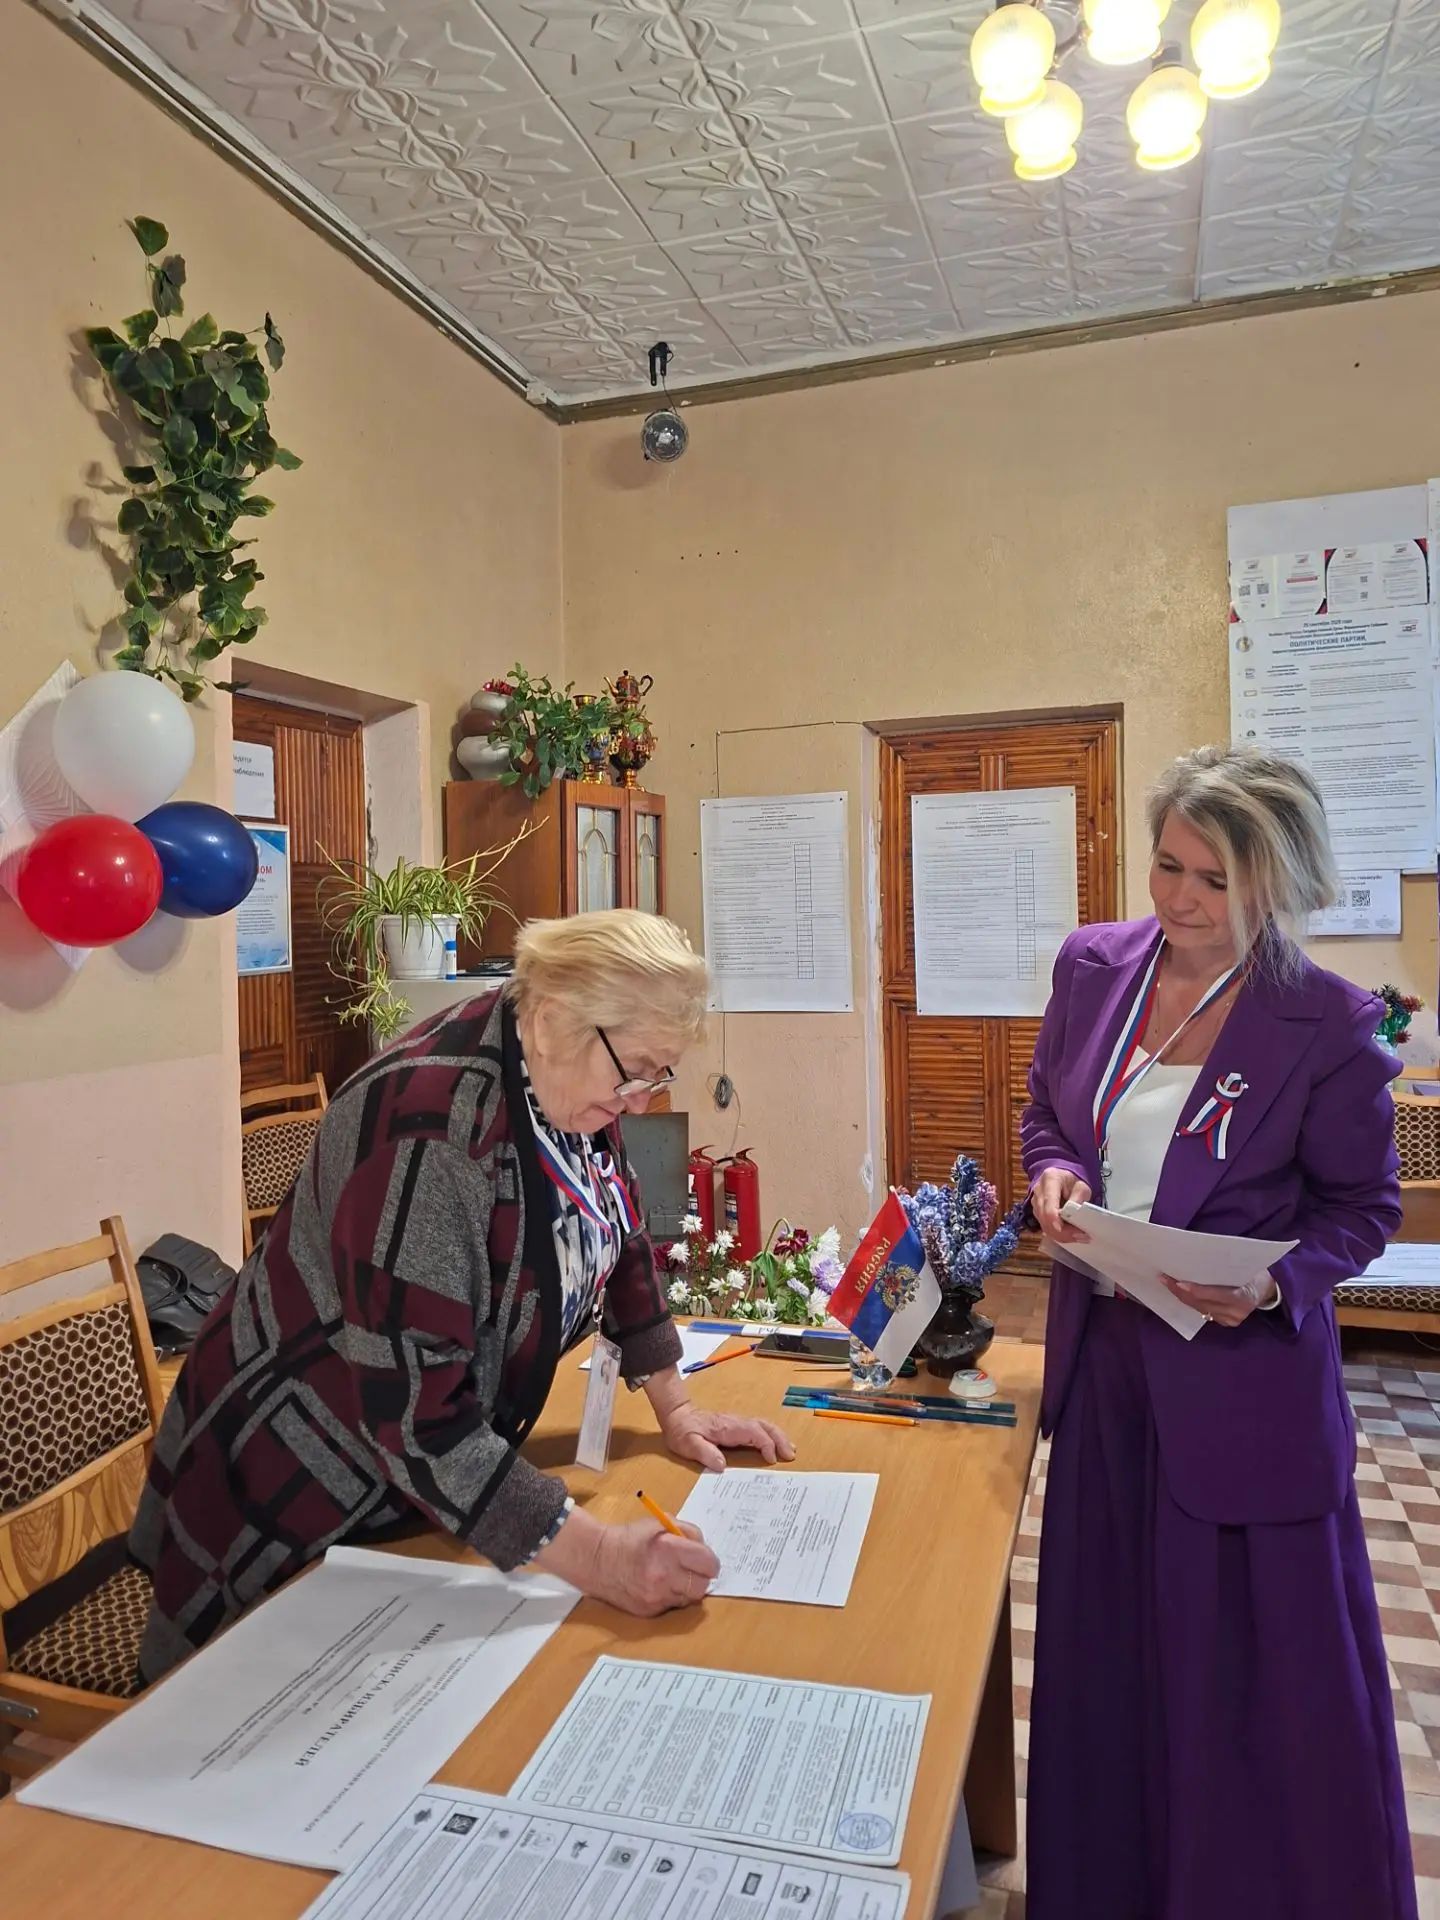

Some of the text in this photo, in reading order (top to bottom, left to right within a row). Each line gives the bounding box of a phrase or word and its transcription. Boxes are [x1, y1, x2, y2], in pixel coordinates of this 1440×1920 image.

[1289, 637, 1339, 648] ПОЛИТИЧЕСКИЕ
[855, 1237, 891, 1293] РОССИЯ
[411, 1623, 445, 1651] КНИГА
[371, 1653, 415, 1692] СПИСКА
[294, 1692, 375, 1767] ИЗБИРАТЕЛЕЙ
